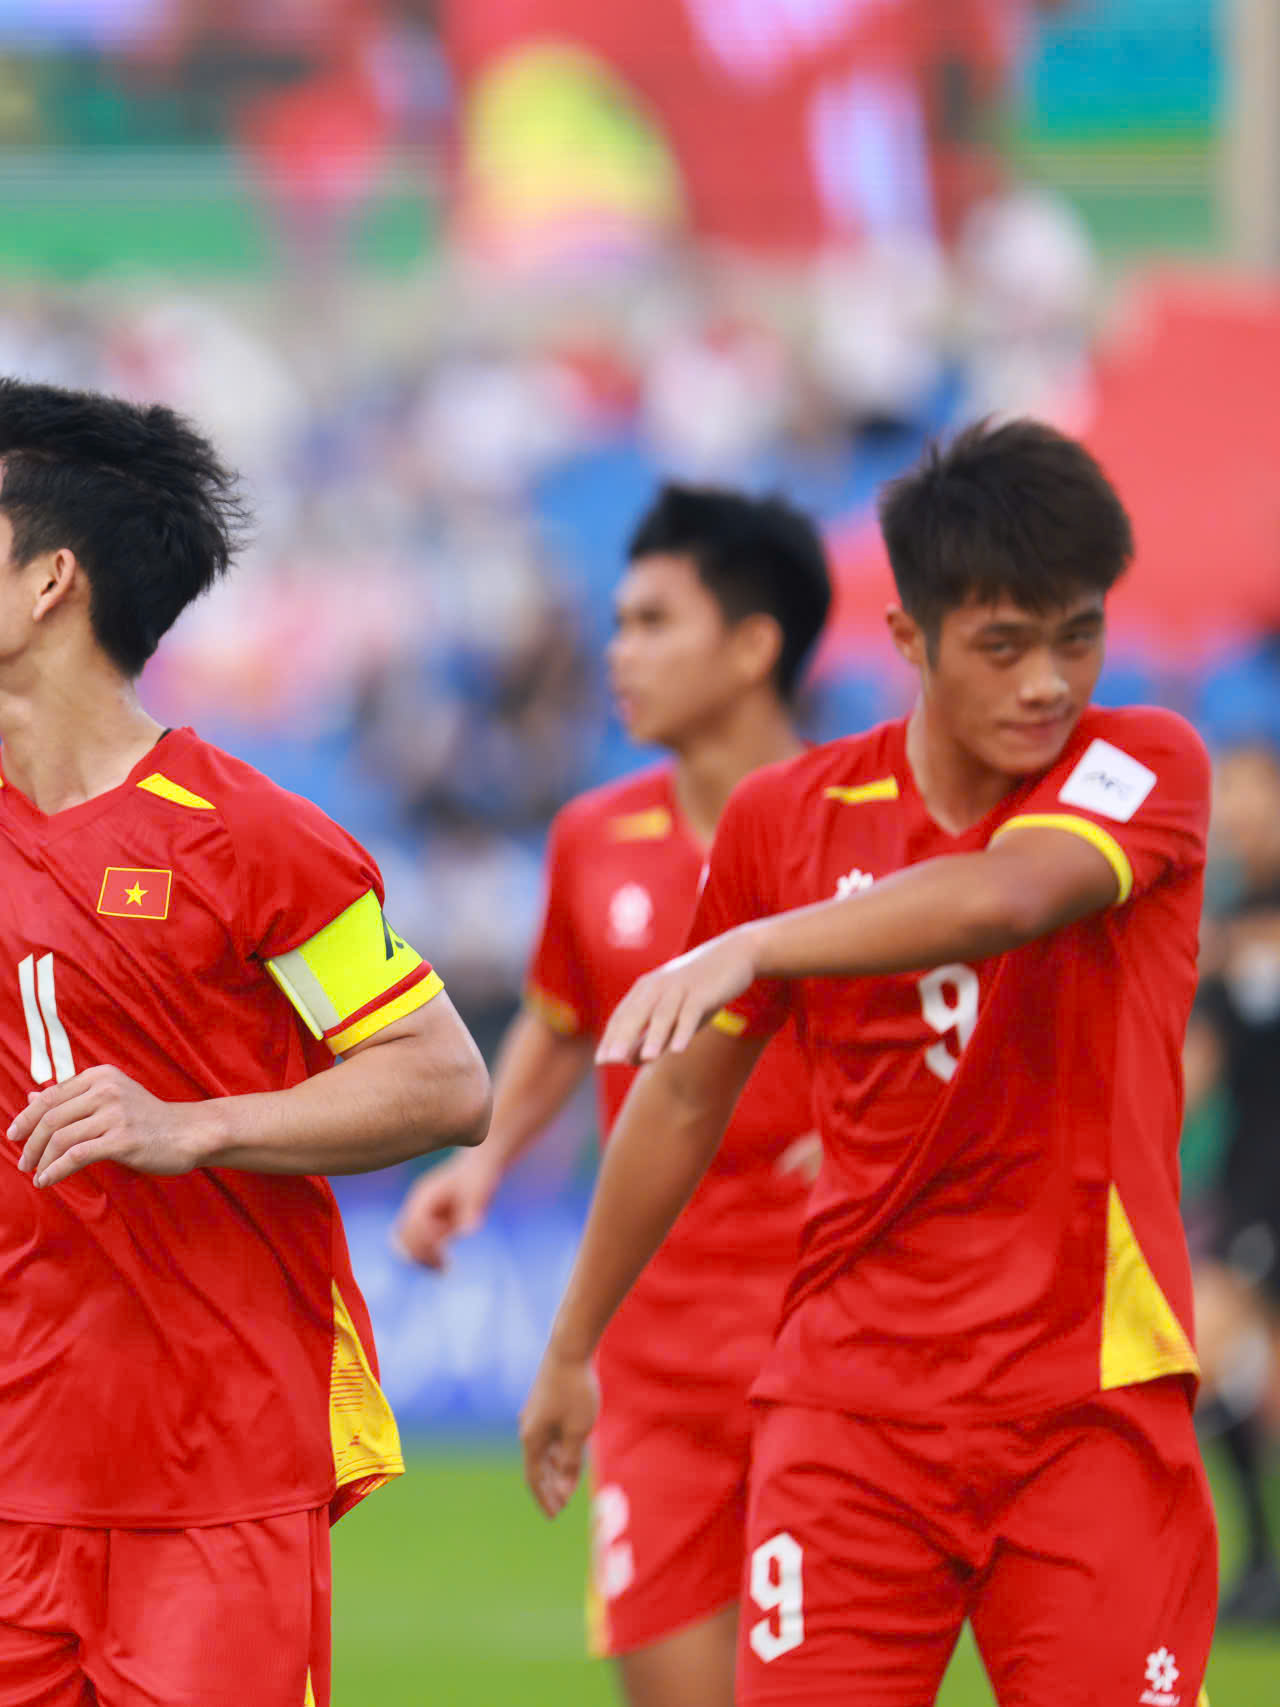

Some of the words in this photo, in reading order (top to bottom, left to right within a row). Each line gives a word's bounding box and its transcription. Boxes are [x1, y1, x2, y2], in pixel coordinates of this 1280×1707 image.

[18, 951, 76, 1085] 11
[918, 963, 979, 1083] 9
[750, 1531, 804, 1664] 9
